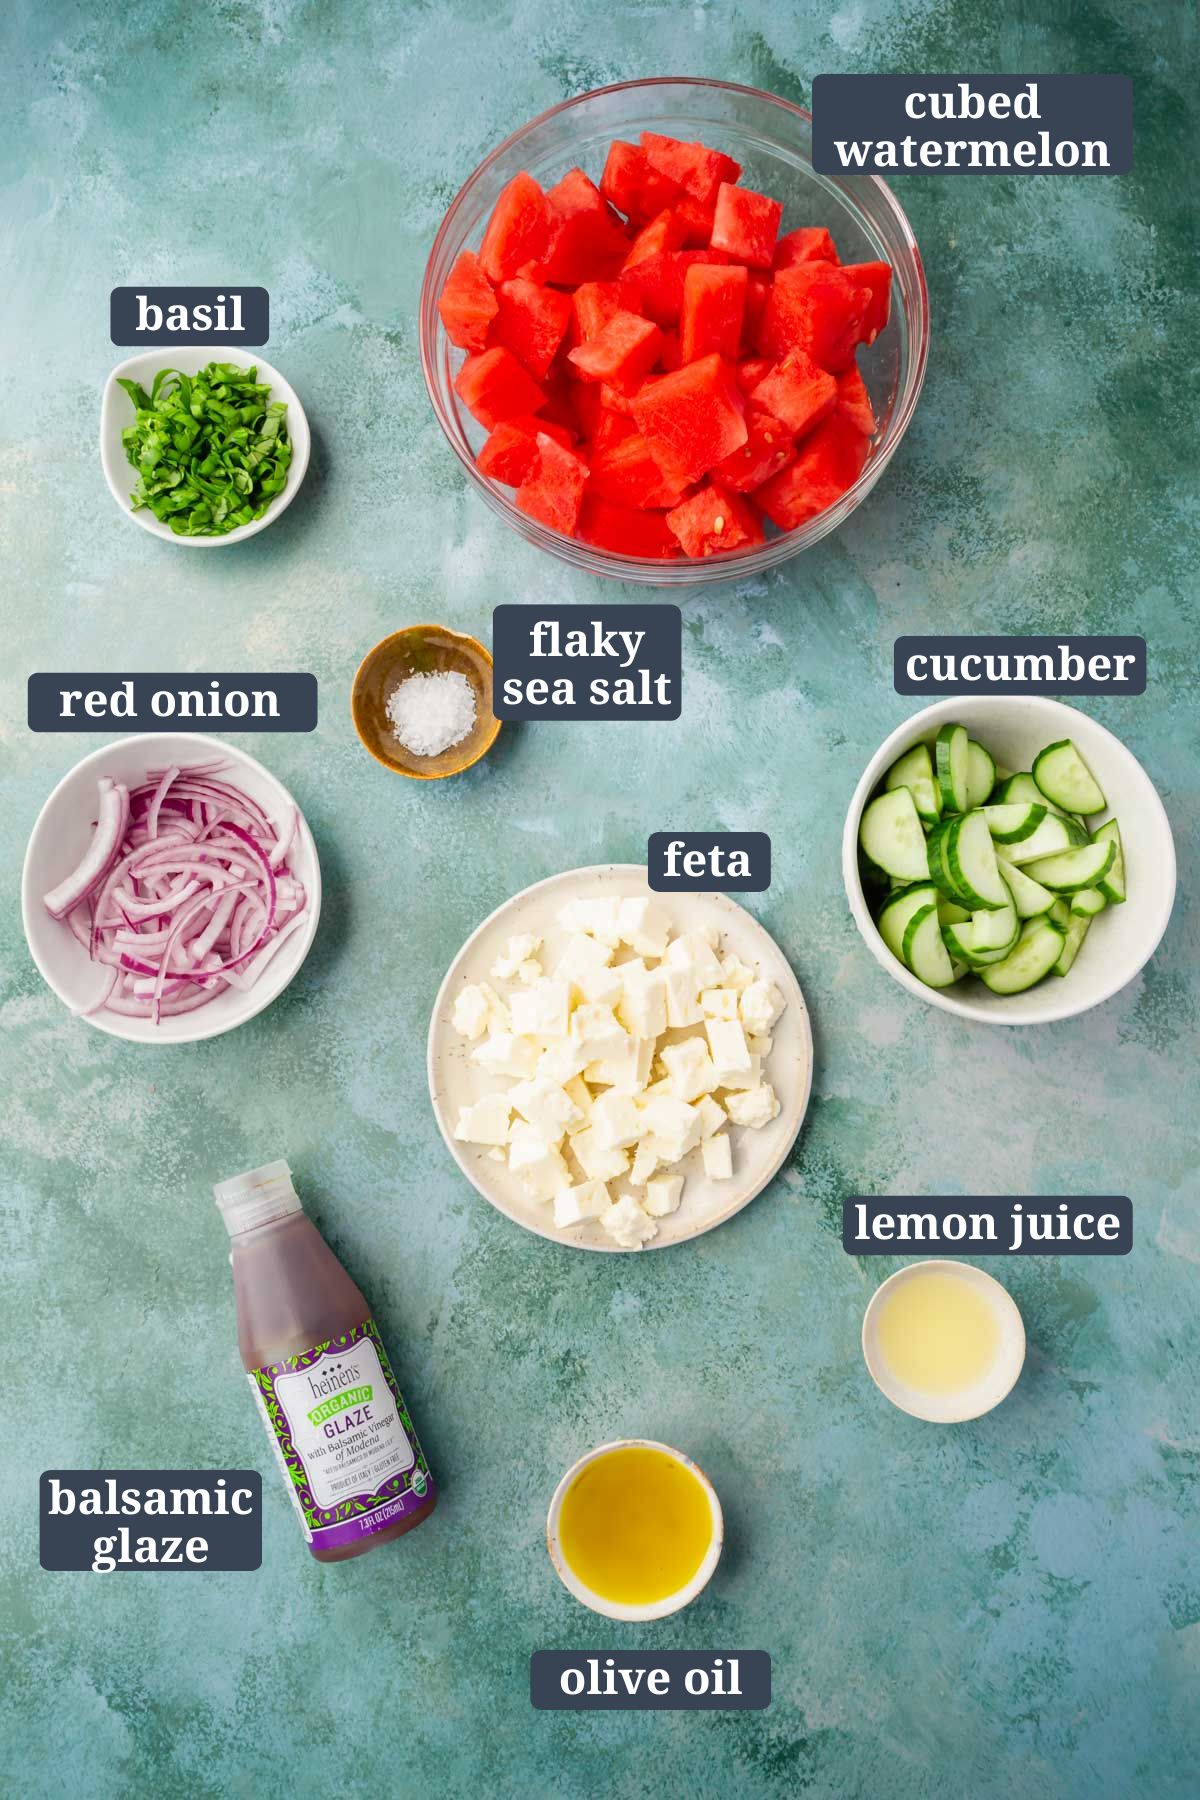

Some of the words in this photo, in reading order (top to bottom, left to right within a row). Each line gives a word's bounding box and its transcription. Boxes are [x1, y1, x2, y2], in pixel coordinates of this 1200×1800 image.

[311, 1387, 370, 1423] ORGANIC
[323, 1404, 374, 1439] GLAZE
[307, 1447, 327, 1460] with
[327, 1429, 369, 1453] Balsamic
[368, 1413, 395, 1433] Vinegar
[335, 1449, 345, 1462] of
[346, 1434, 380, 1457] Modena
